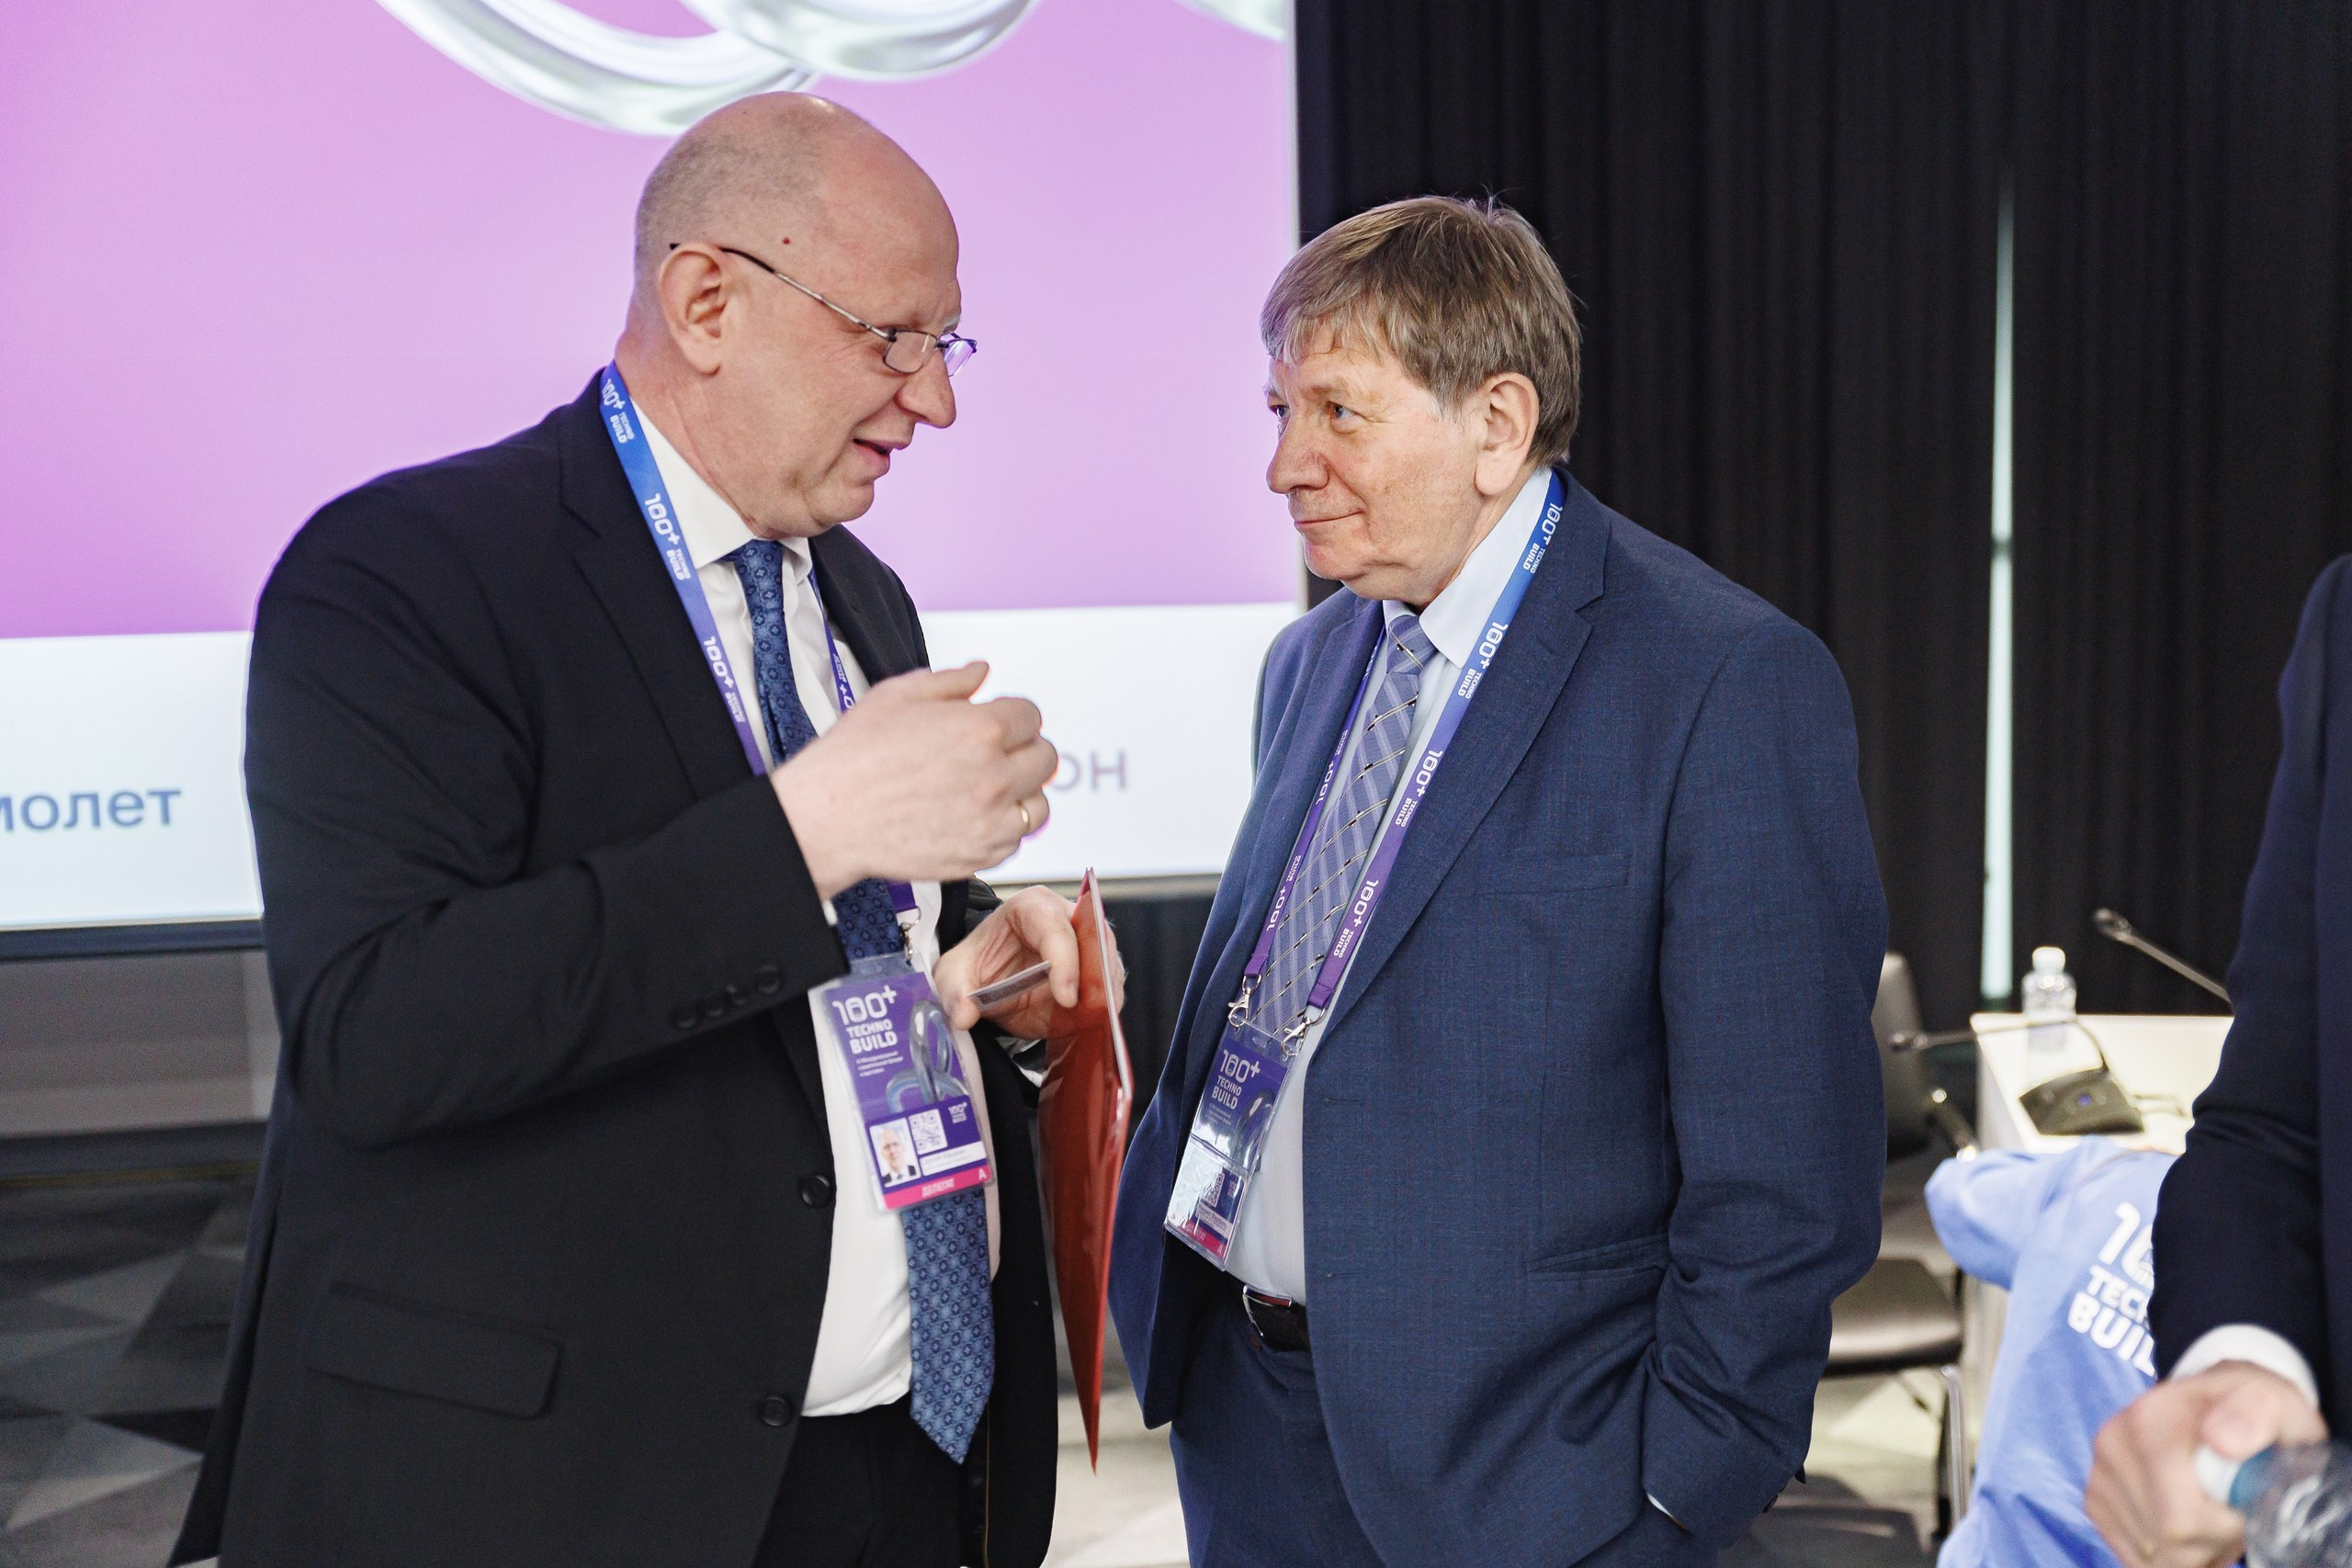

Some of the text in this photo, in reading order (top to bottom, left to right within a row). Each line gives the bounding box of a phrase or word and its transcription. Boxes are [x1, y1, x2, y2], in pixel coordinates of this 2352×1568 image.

[644, 492, 680, 545] 100+
[1541, 502, 1564, 546] 100+
[1522, 542, 1540, 570] BUILD
[703, 636, 734, 689] 100+
[1478, 622, 1509, 670] 100+
[1457, 668, 1476, 696] BUILD
[1416, 750, 1443, 797] 100+
[1395, 797, 1413, 826] BUILD
[1266, 886, 1286, 931] 100+
[1353, 880, 1379, 928] 100+
[1333, 928, 1351, 956] BUILD
[831, 985, 898, 1026] 100+
[846, 1019, 894, 1039] TECHNO
[849, 1031, 898, 1055] BUILD
[1220, 1049, 1261, 1083] 100+
[1211, 1085, 1238, 1110] BUILD
[1216, 1075, 1242, 1097] TECHNO
[2067, 1291, 2156, 1379] BUIL
